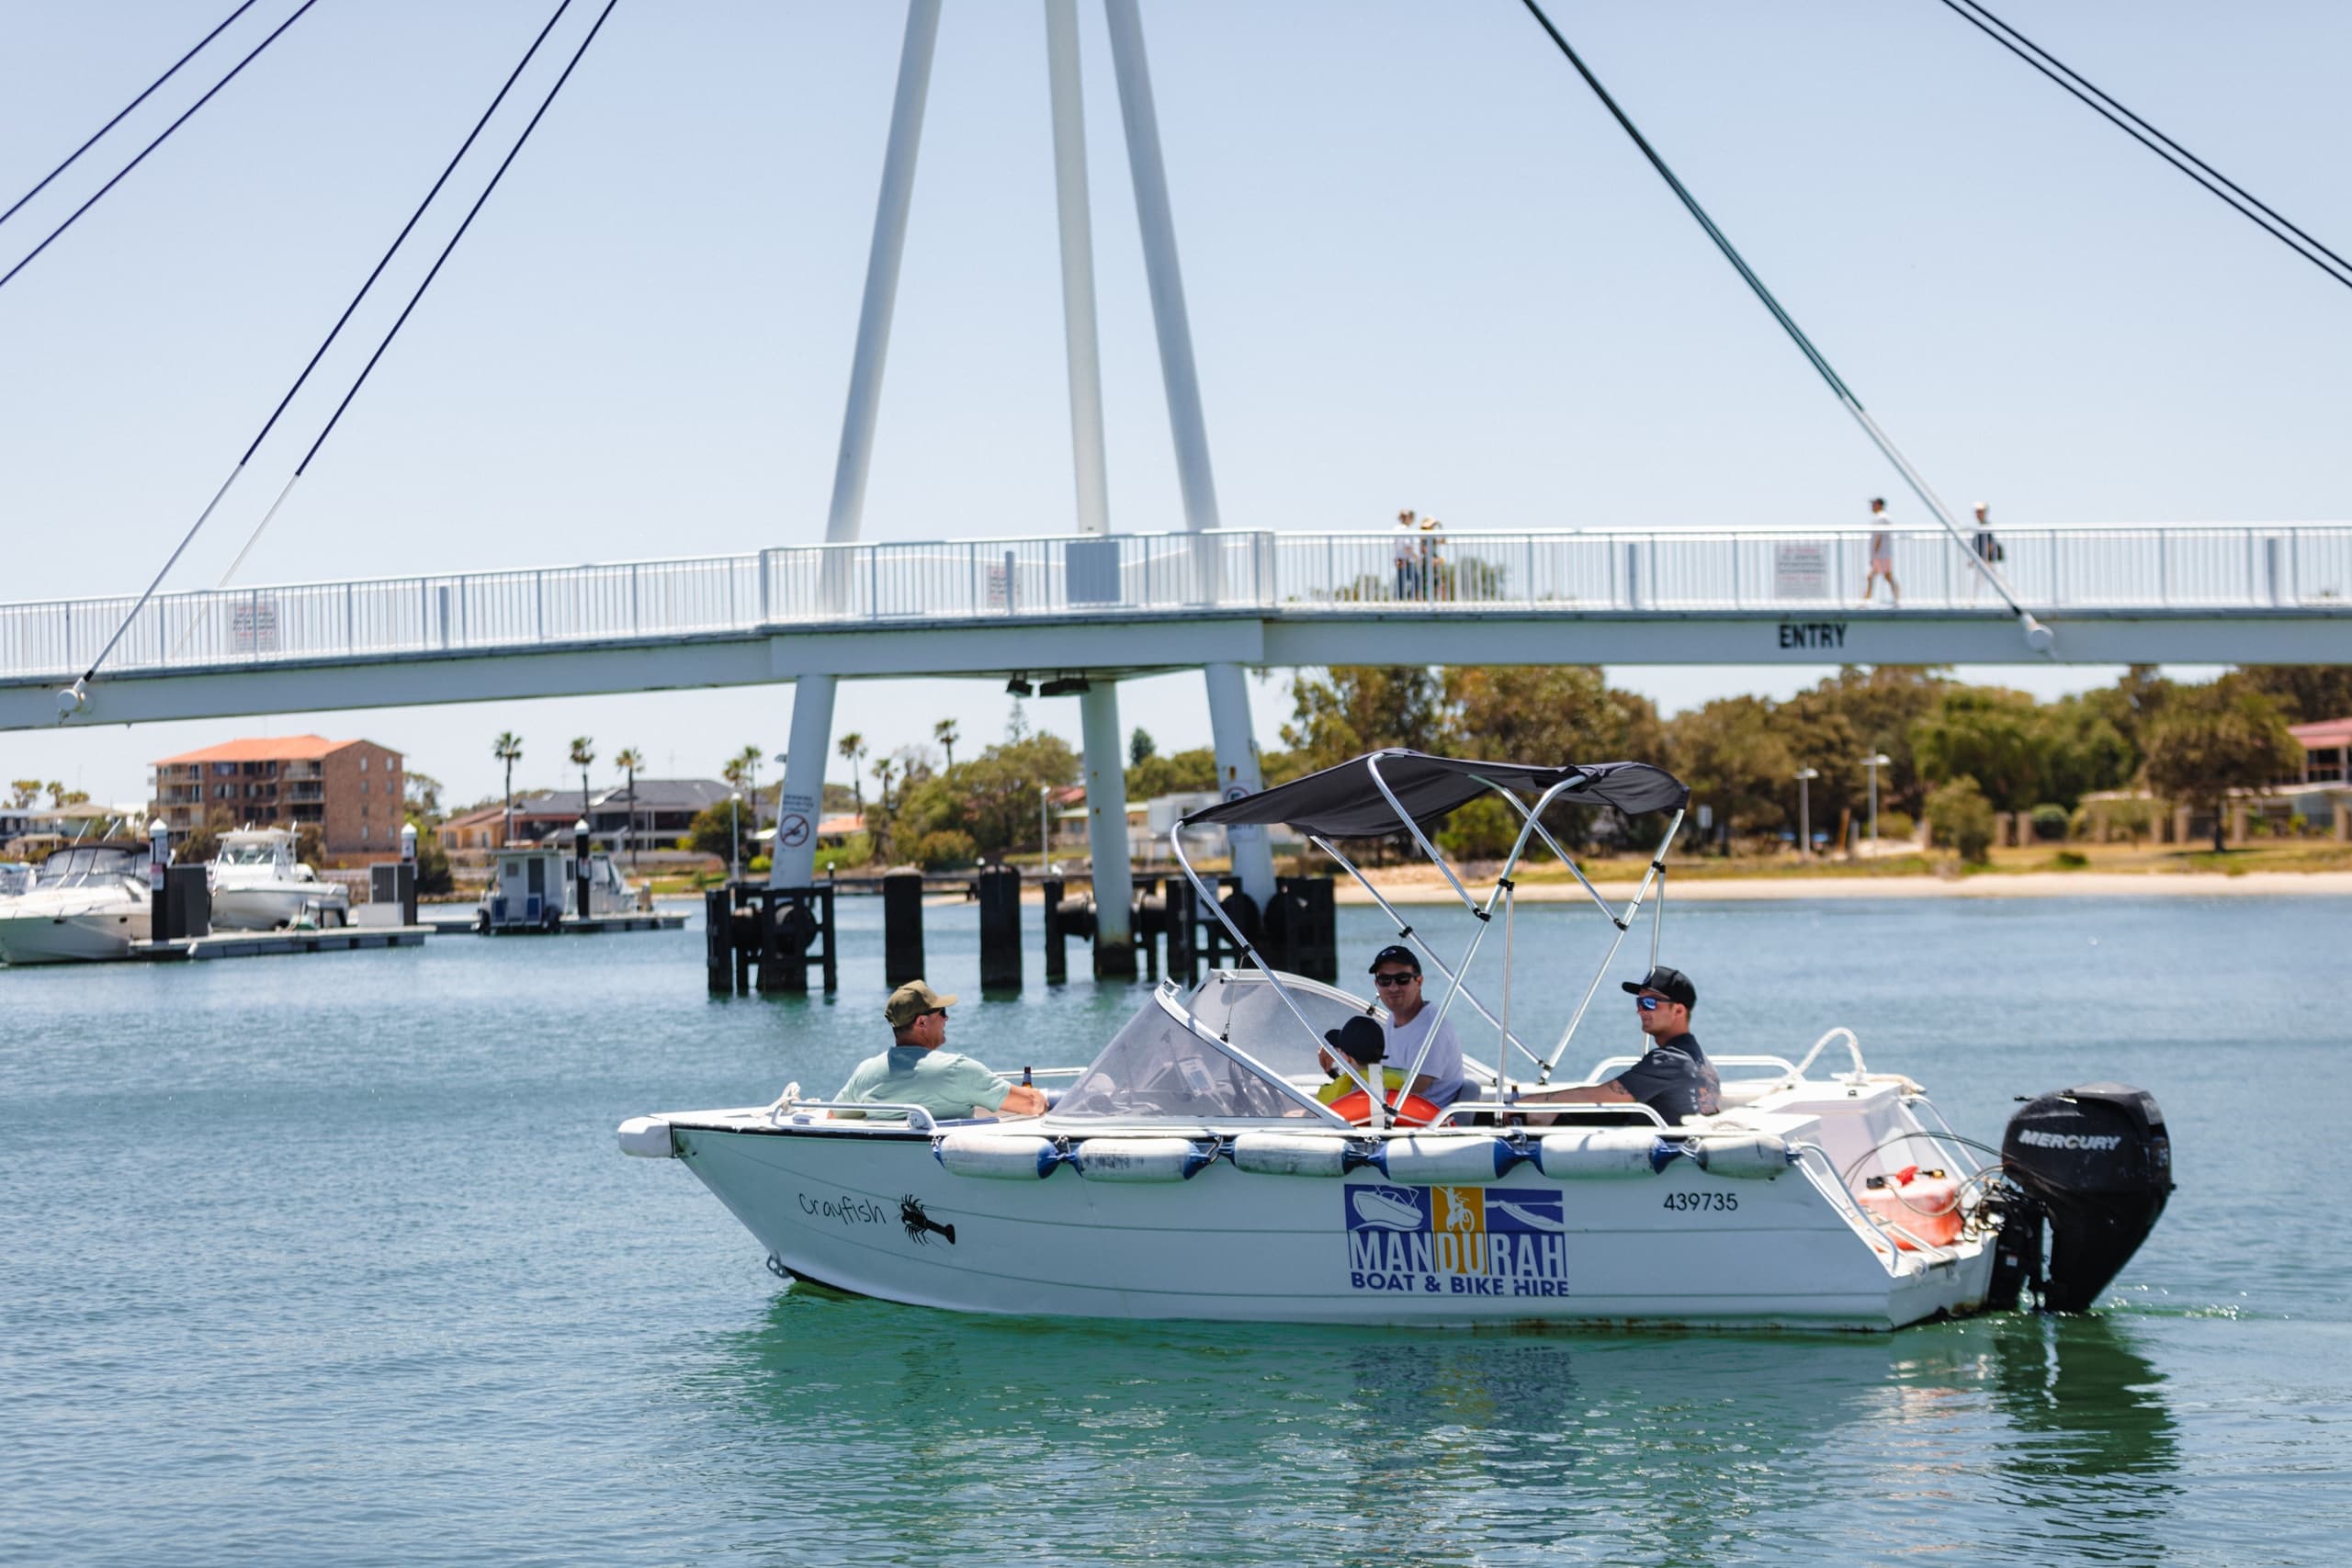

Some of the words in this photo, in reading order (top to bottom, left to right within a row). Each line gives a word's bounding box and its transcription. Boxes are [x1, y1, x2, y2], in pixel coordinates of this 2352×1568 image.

[1779, 623, 1848, 649] ENTRY
[2018, 1129, 2121, 1150] MERCURY
[798, 1192, 887, 1225] Crayfish
[1663, 1192, 1738, 1212] 439735
[1349, 1231, 1566, 1278] MANDURAH
[1351, 1271, 1415, 1292] BOAT
[1424, 1275, 1442, 1293] &
[1450, 1276, 1504, 1296] BIKE
[1514, 1279, 1569, 1297] HIRE
